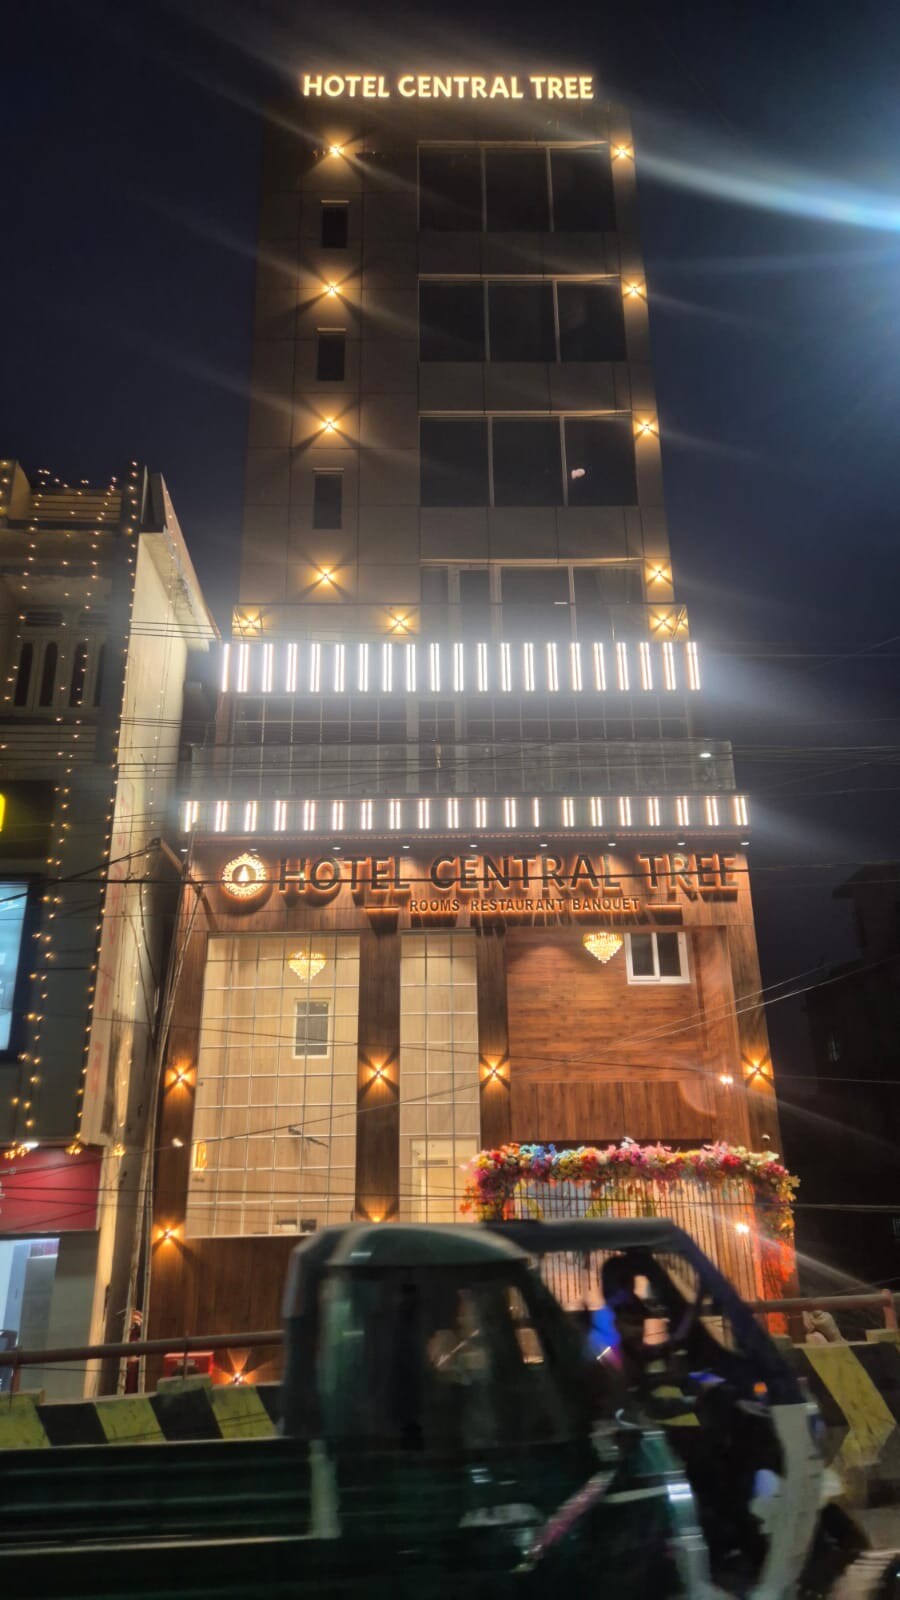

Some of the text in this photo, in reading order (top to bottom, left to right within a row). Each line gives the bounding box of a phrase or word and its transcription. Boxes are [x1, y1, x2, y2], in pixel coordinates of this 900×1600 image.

[303, 75, 594, 99] HOTEL CENTRAL TREE
[278, 853, 738, 893] HOTEL CENTRAL TREE
[409, 898, 640, 913] ROOMS RESTAURANT BANQUET
